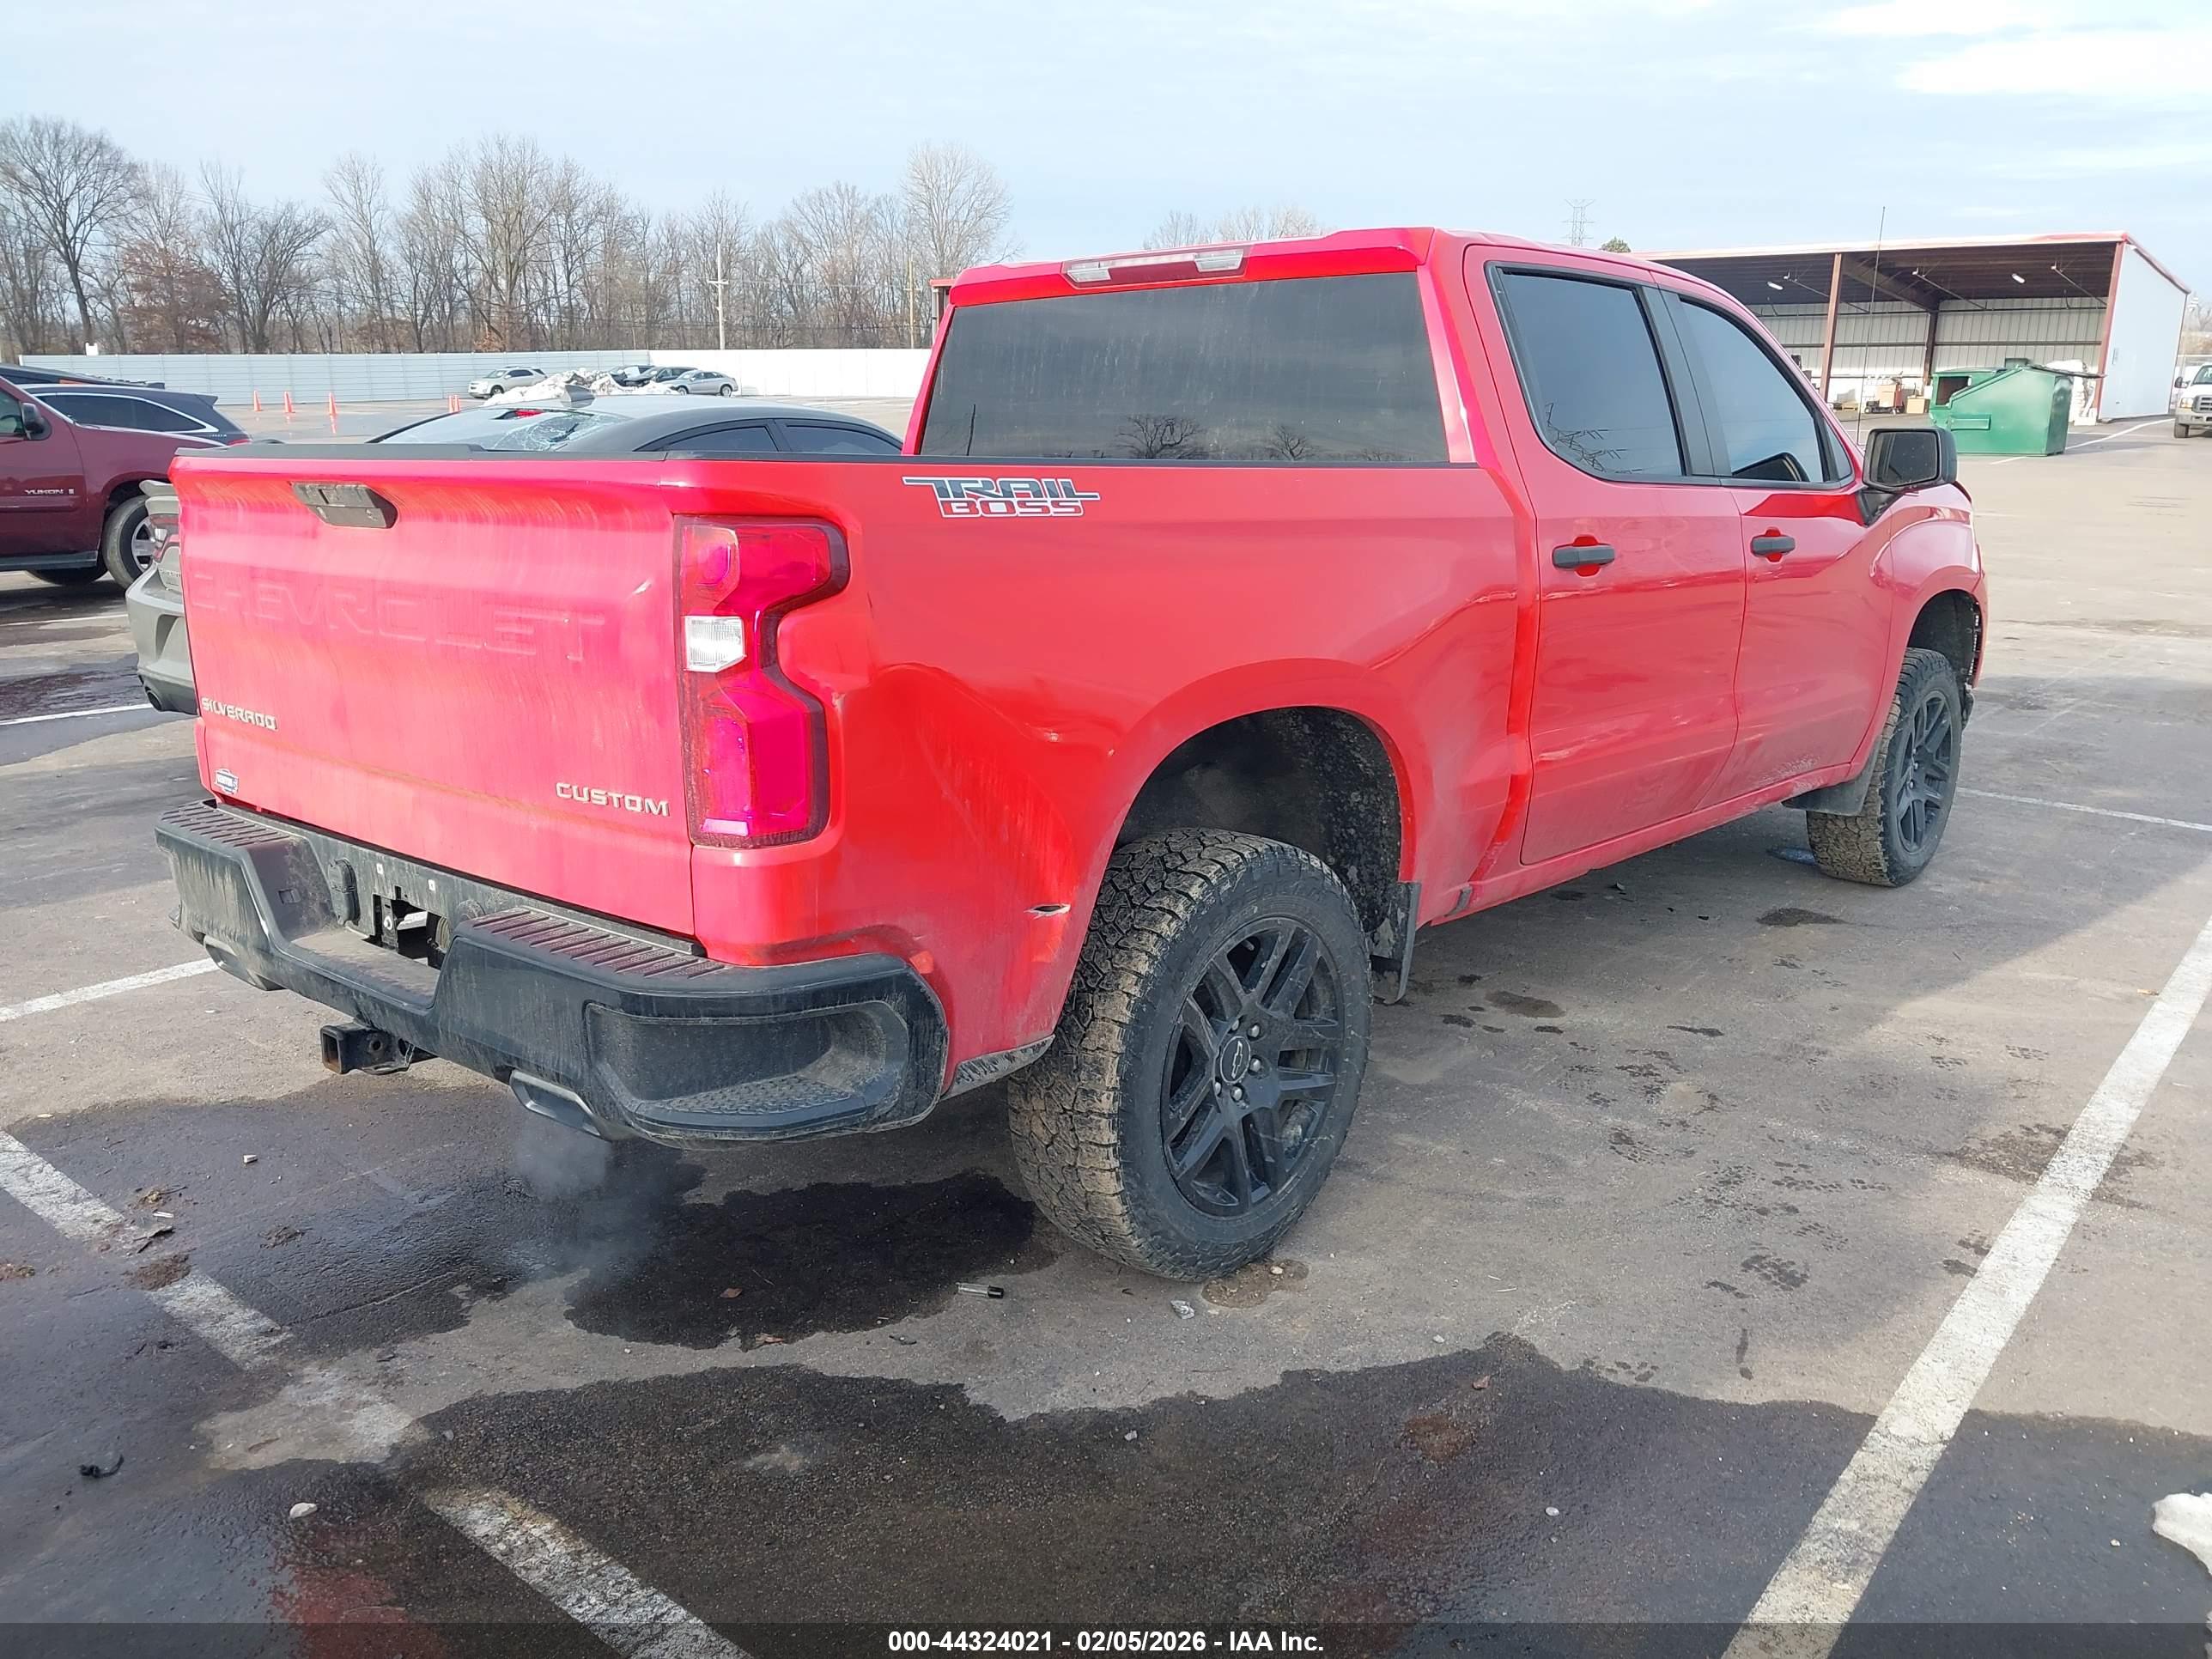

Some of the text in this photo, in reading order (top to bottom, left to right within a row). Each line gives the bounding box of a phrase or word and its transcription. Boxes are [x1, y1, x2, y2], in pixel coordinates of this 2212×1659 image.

[902, 477, 1101, 501] TRAIL
[939, 499, 1085, 519] BOSS
[201, 697, 278, 730] SILVERADO
[556, 782, 670, 817] CUSTOM
